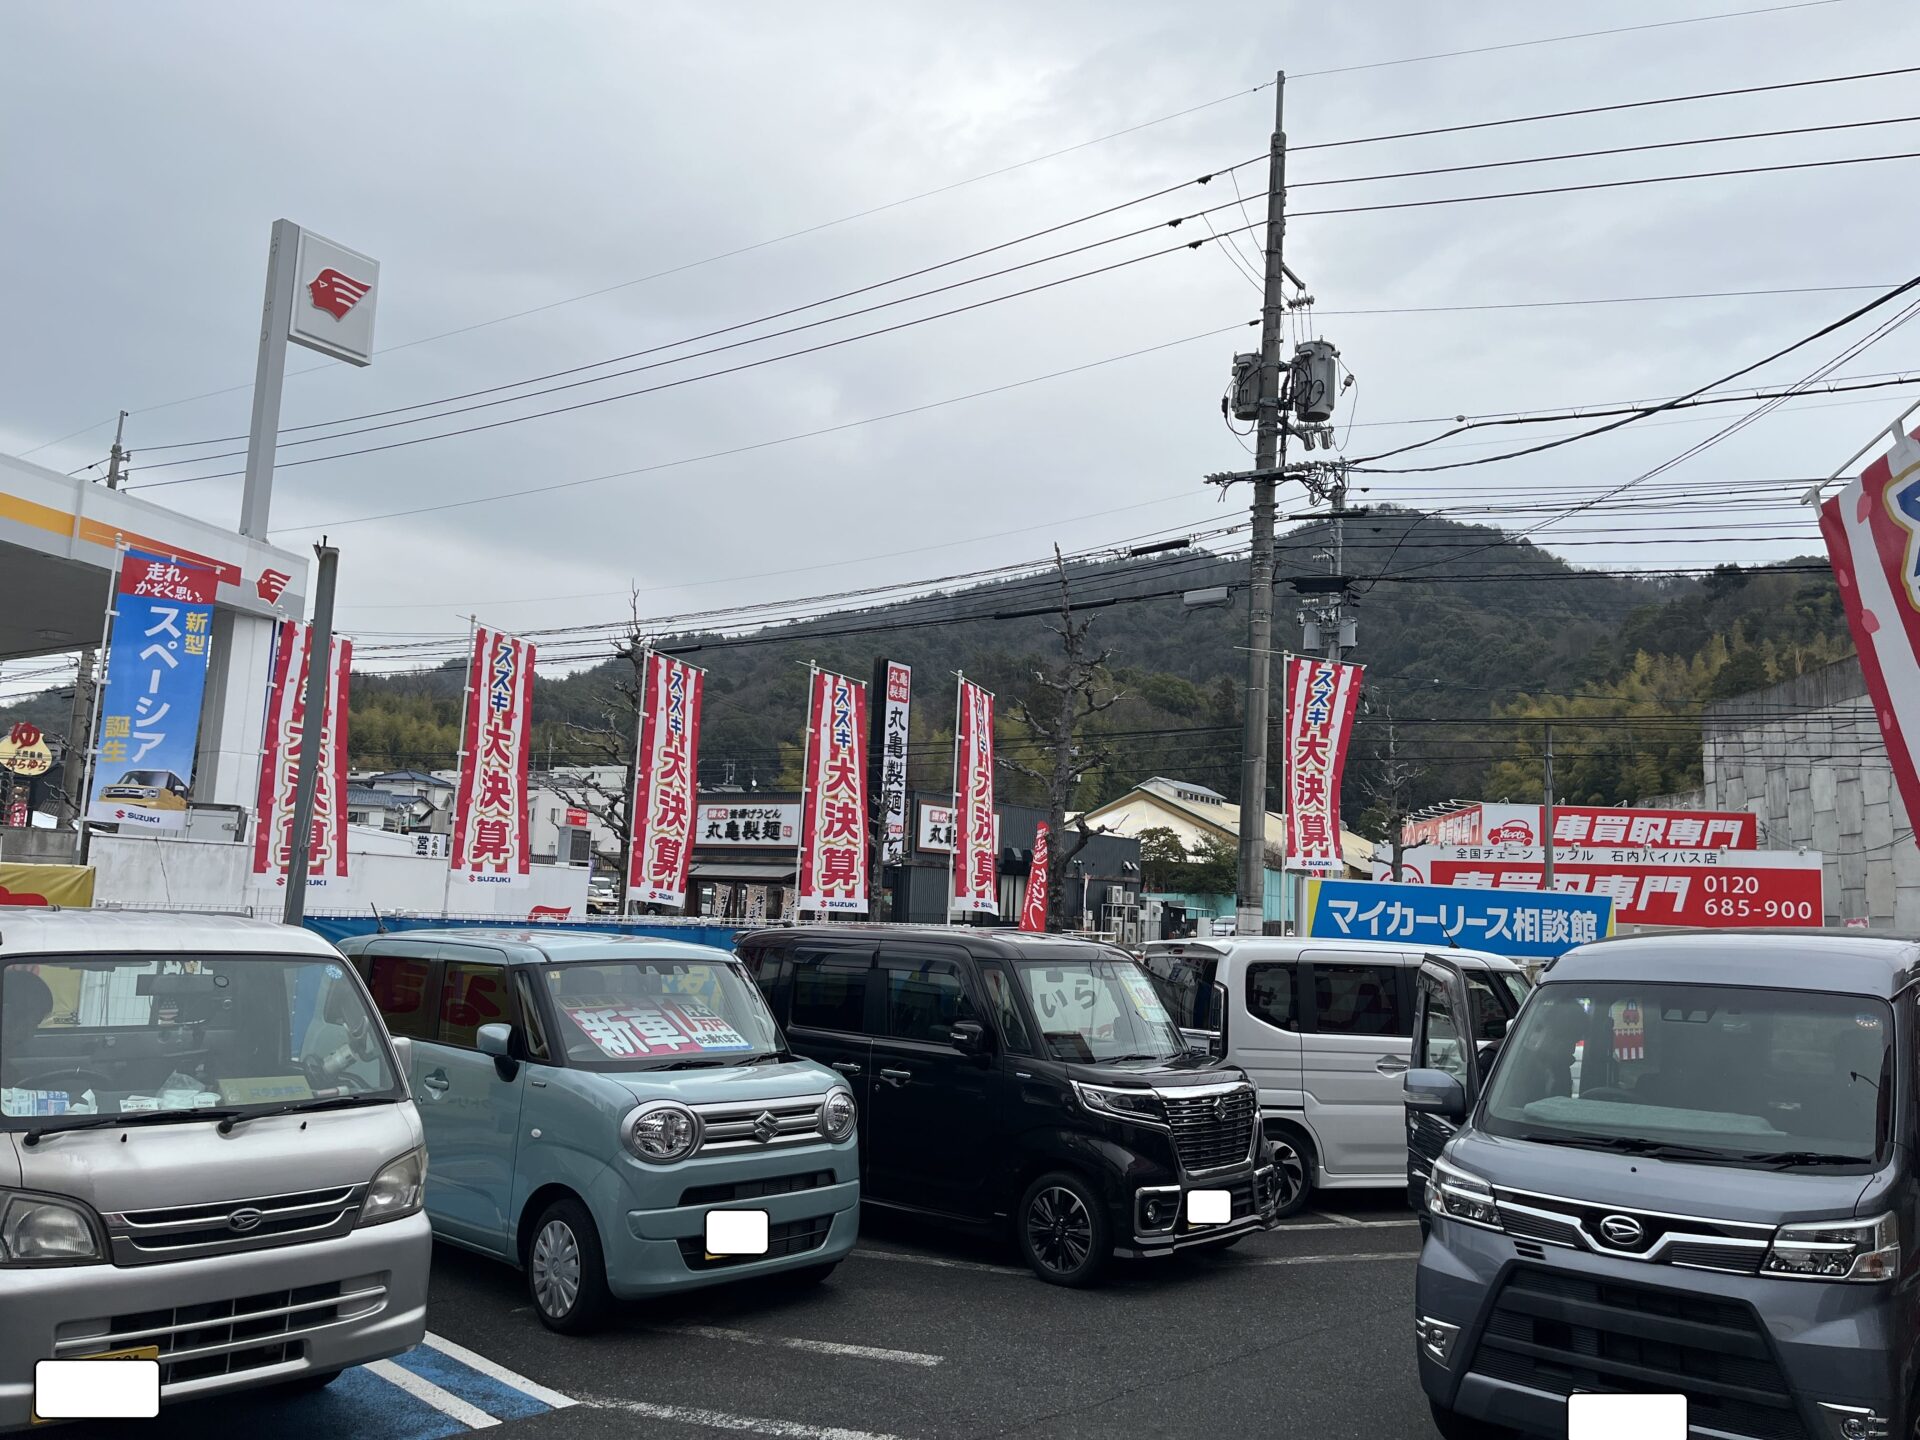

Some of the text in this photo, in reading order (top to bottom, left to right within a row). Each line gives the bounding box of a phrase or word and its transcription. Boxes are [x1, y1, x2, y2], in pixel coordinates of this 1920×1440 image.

[145, 563, 188, 584] 走れ！
[134, 581, 203, 603] かぞく思い。
[184, 611, 208, 655] 新型
[131, 606, 182, 763] スペーシア
[11, 722, 41, 749] ゆ
[102, 716, 131, 763] 誕生
[471, 643, 514, 861] スズキ大決算
[6, 758, 47, 770] ゆらゆら
[652, 671, 687, 880] スズキ大決算
[1296, 669, 1332, 848] スズキ大決算
[821, 687, 858, 887] スズキ大決算
[128, 812, 160, 823] SUZUKI
[1553, 814, 1743, 848] 車買取専門
[1456, 847, 1717, 864] 全国チェーン ップル 石内バイパス店
[658, 893, 674, 901] SZUKI
[1704, 875, 1759, 894] 0120
[1328, 899, 1598, 945] マイカーリース相談館
[1704, 898, 1812, 919] 685-900
[572, 1007, 691, 1054] 新車
